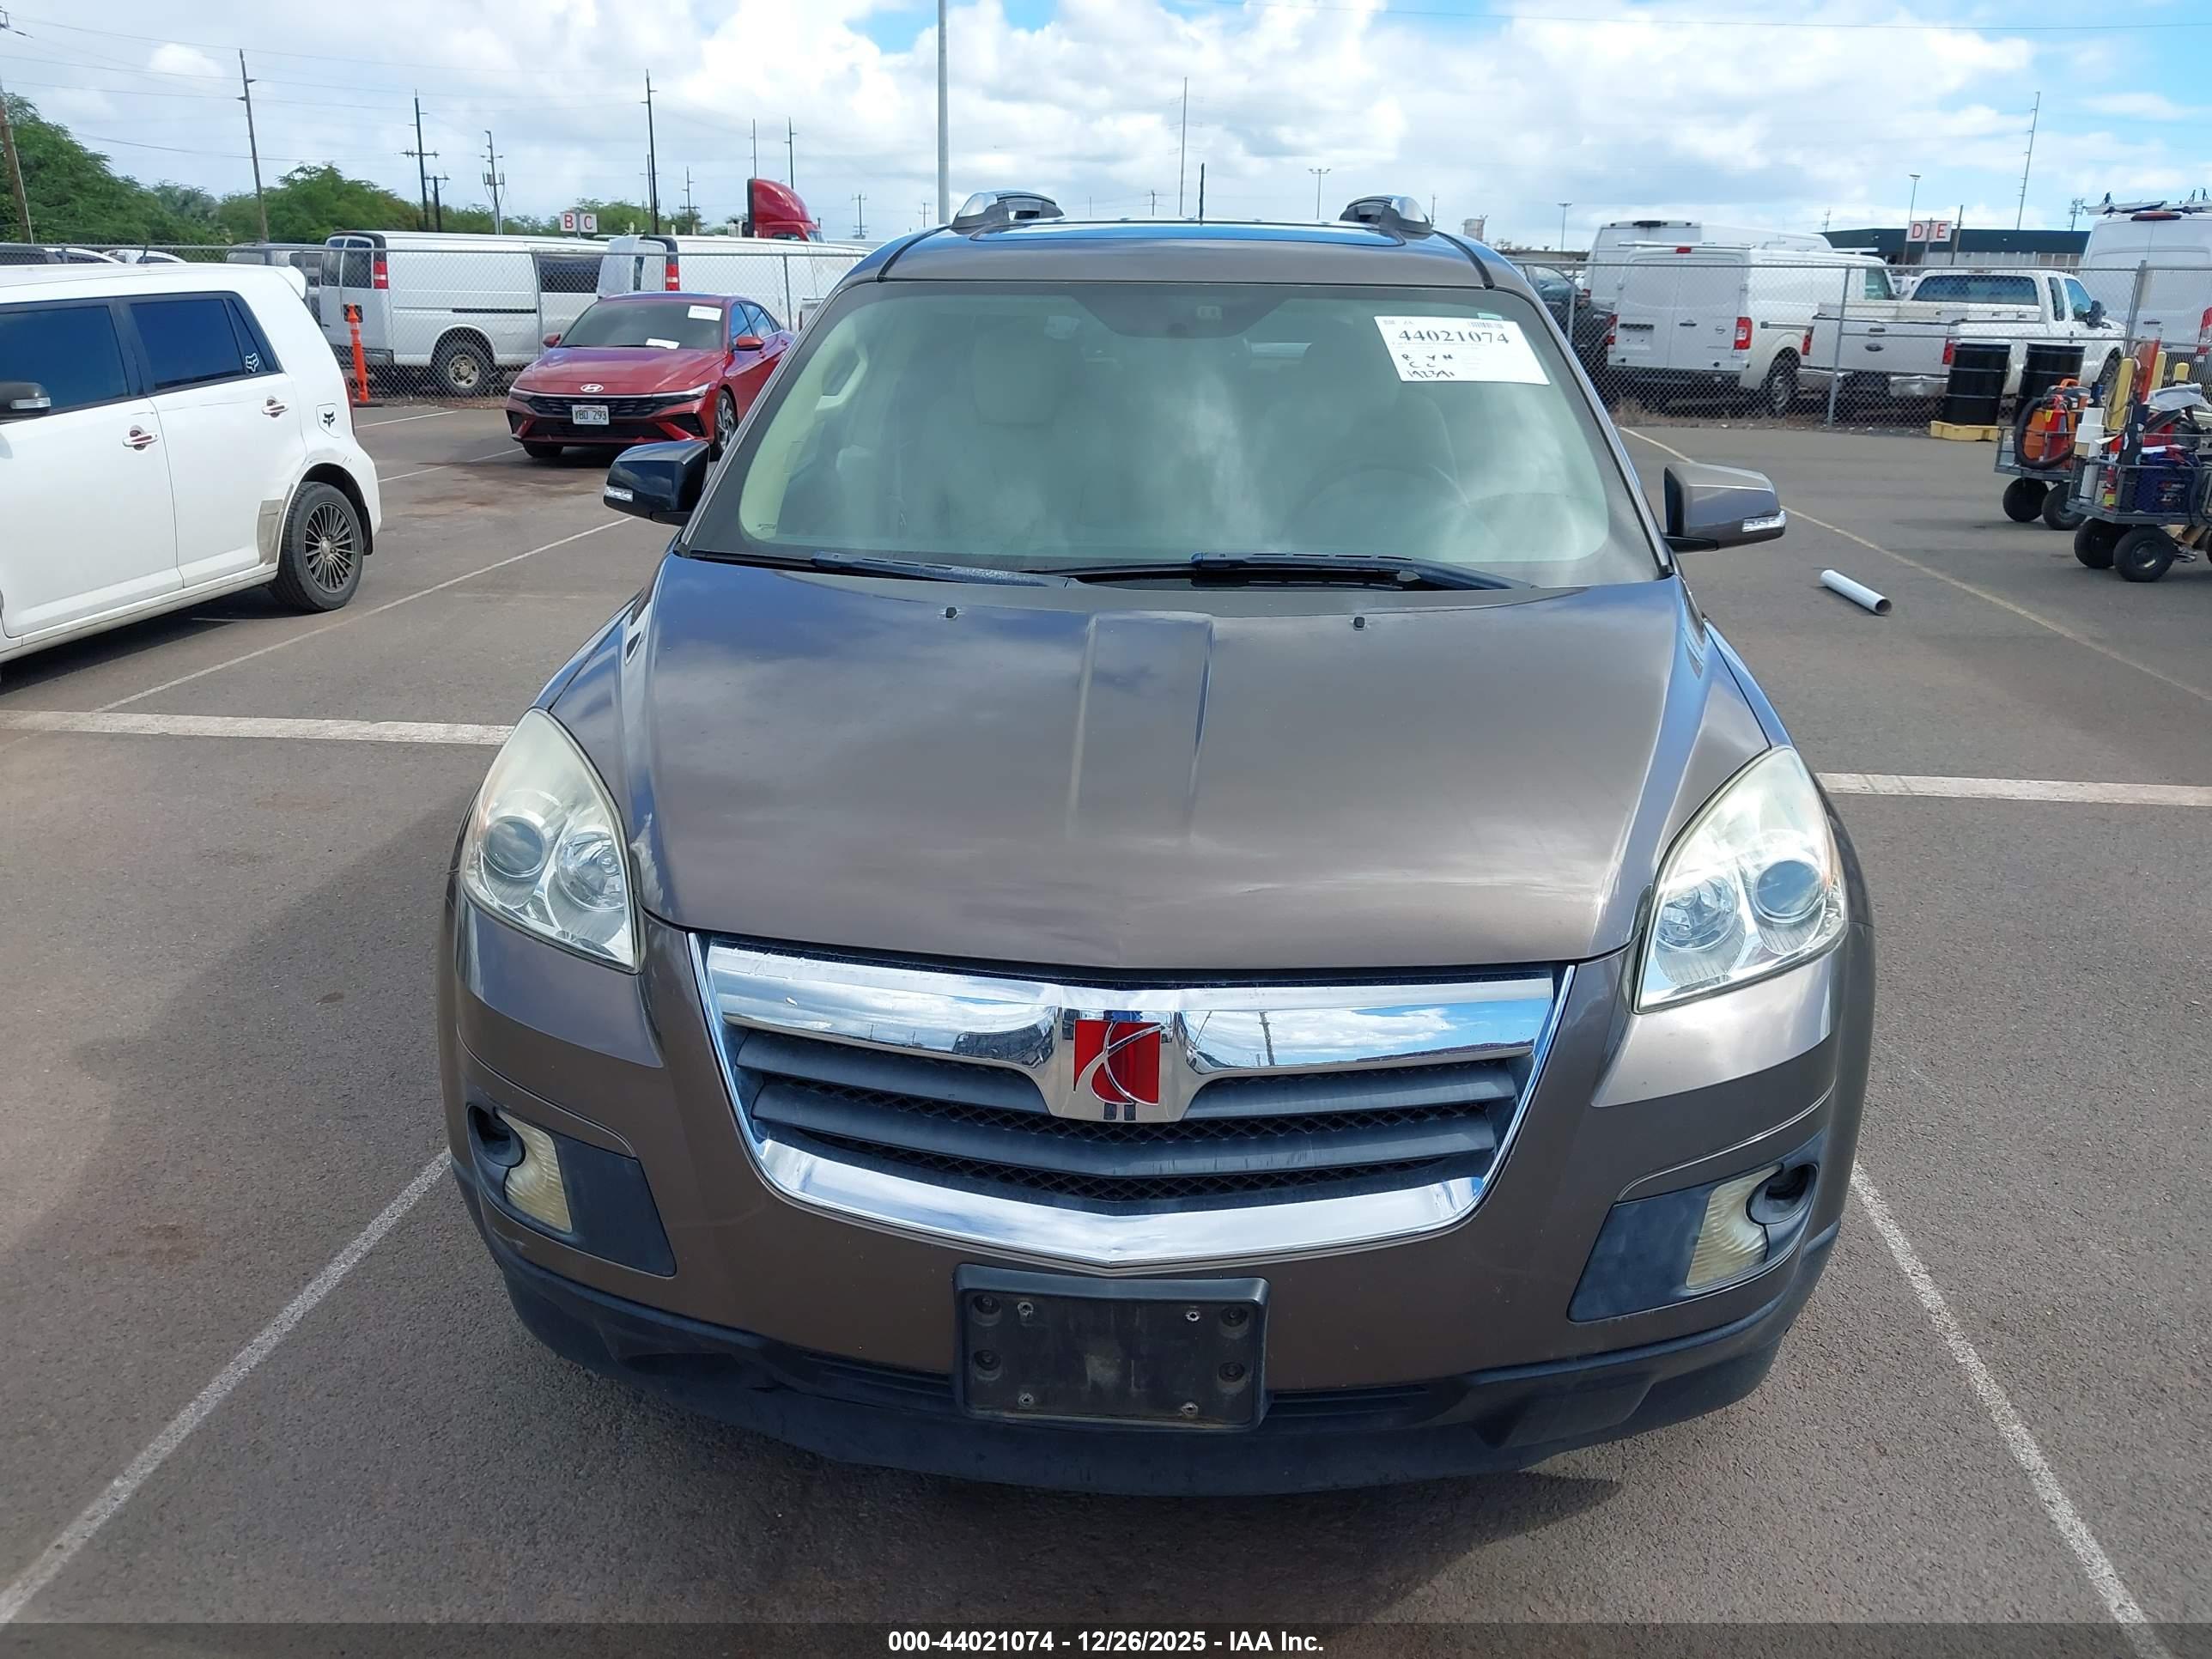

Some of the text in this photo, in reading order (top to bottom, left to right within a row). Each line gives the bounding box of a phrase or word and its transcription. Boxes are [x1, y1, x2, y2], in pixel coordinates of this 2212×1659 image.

[564, 215, 592, 230] B C
[1911, 223, 1948, 239] D E
[1399, 330, 1510, 344] 44021074
